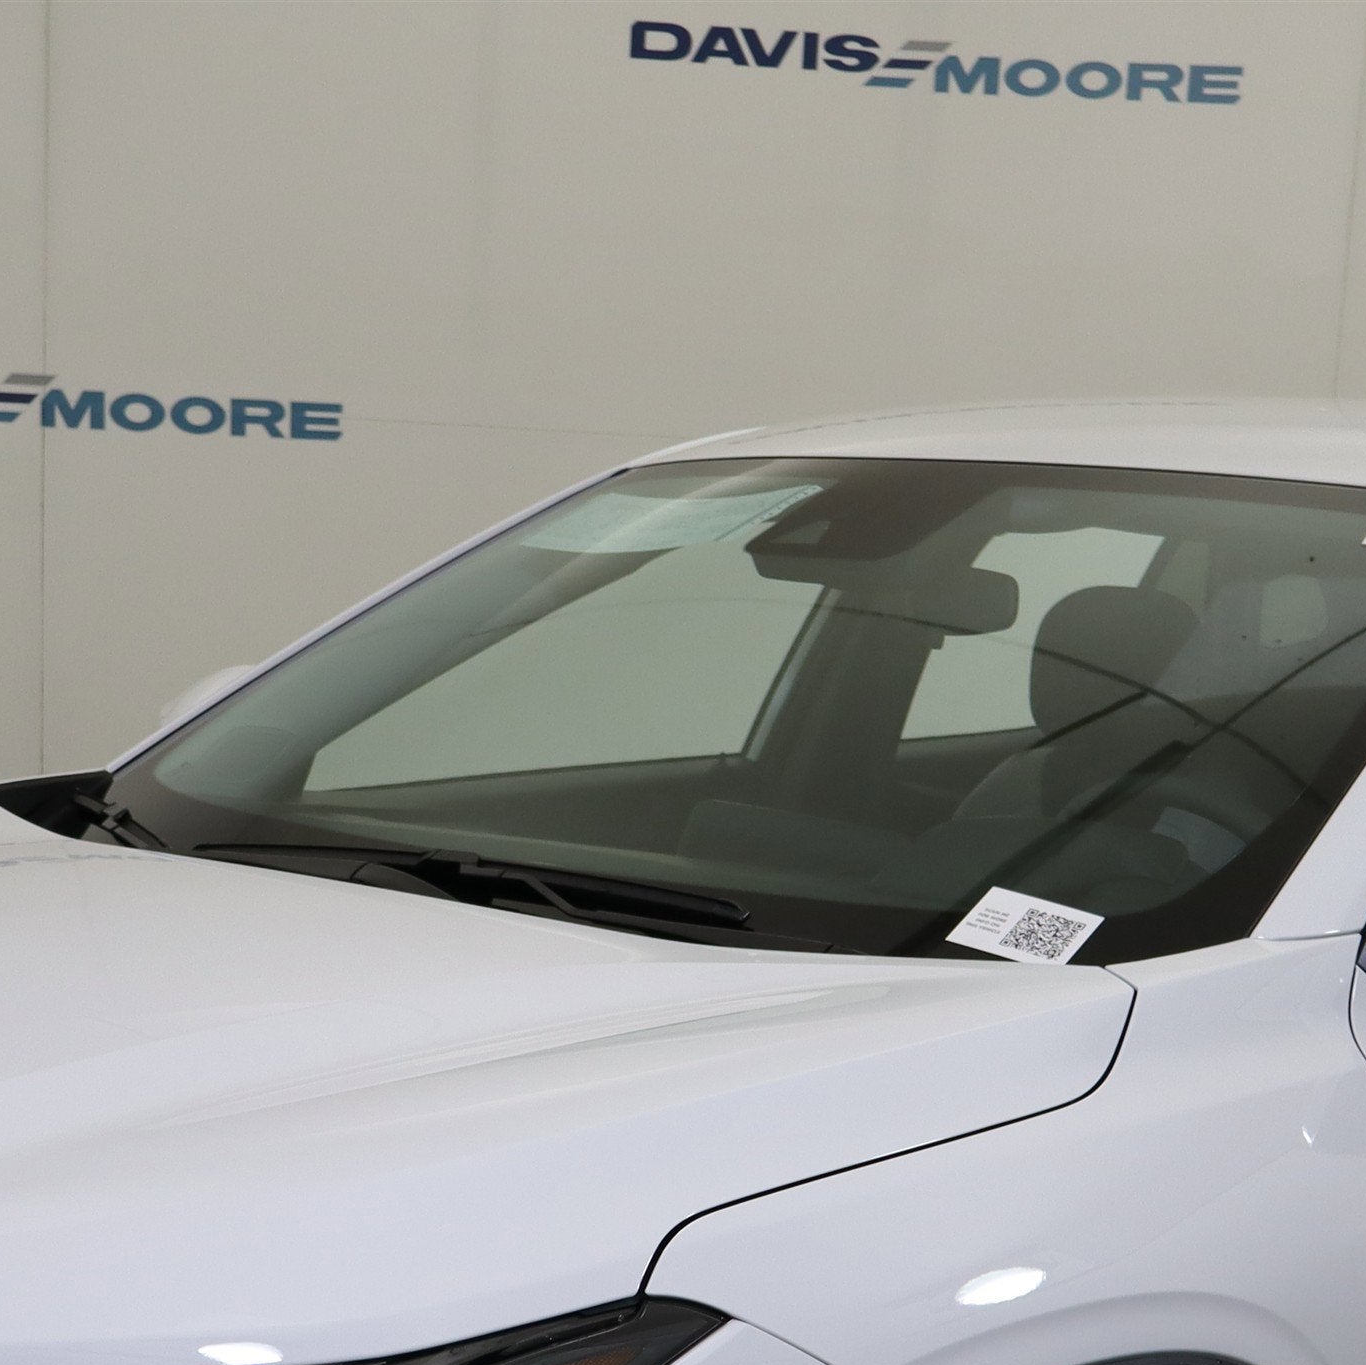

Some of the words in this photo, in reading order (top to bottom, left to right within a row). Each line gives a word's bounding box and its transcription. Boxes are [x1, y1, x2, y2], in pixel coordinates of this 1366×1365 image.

[629, 20, 881, 74] DAVIS
[935, 55, 1244, 105] MOORE
[40, 389, 343, 441] MOORE
